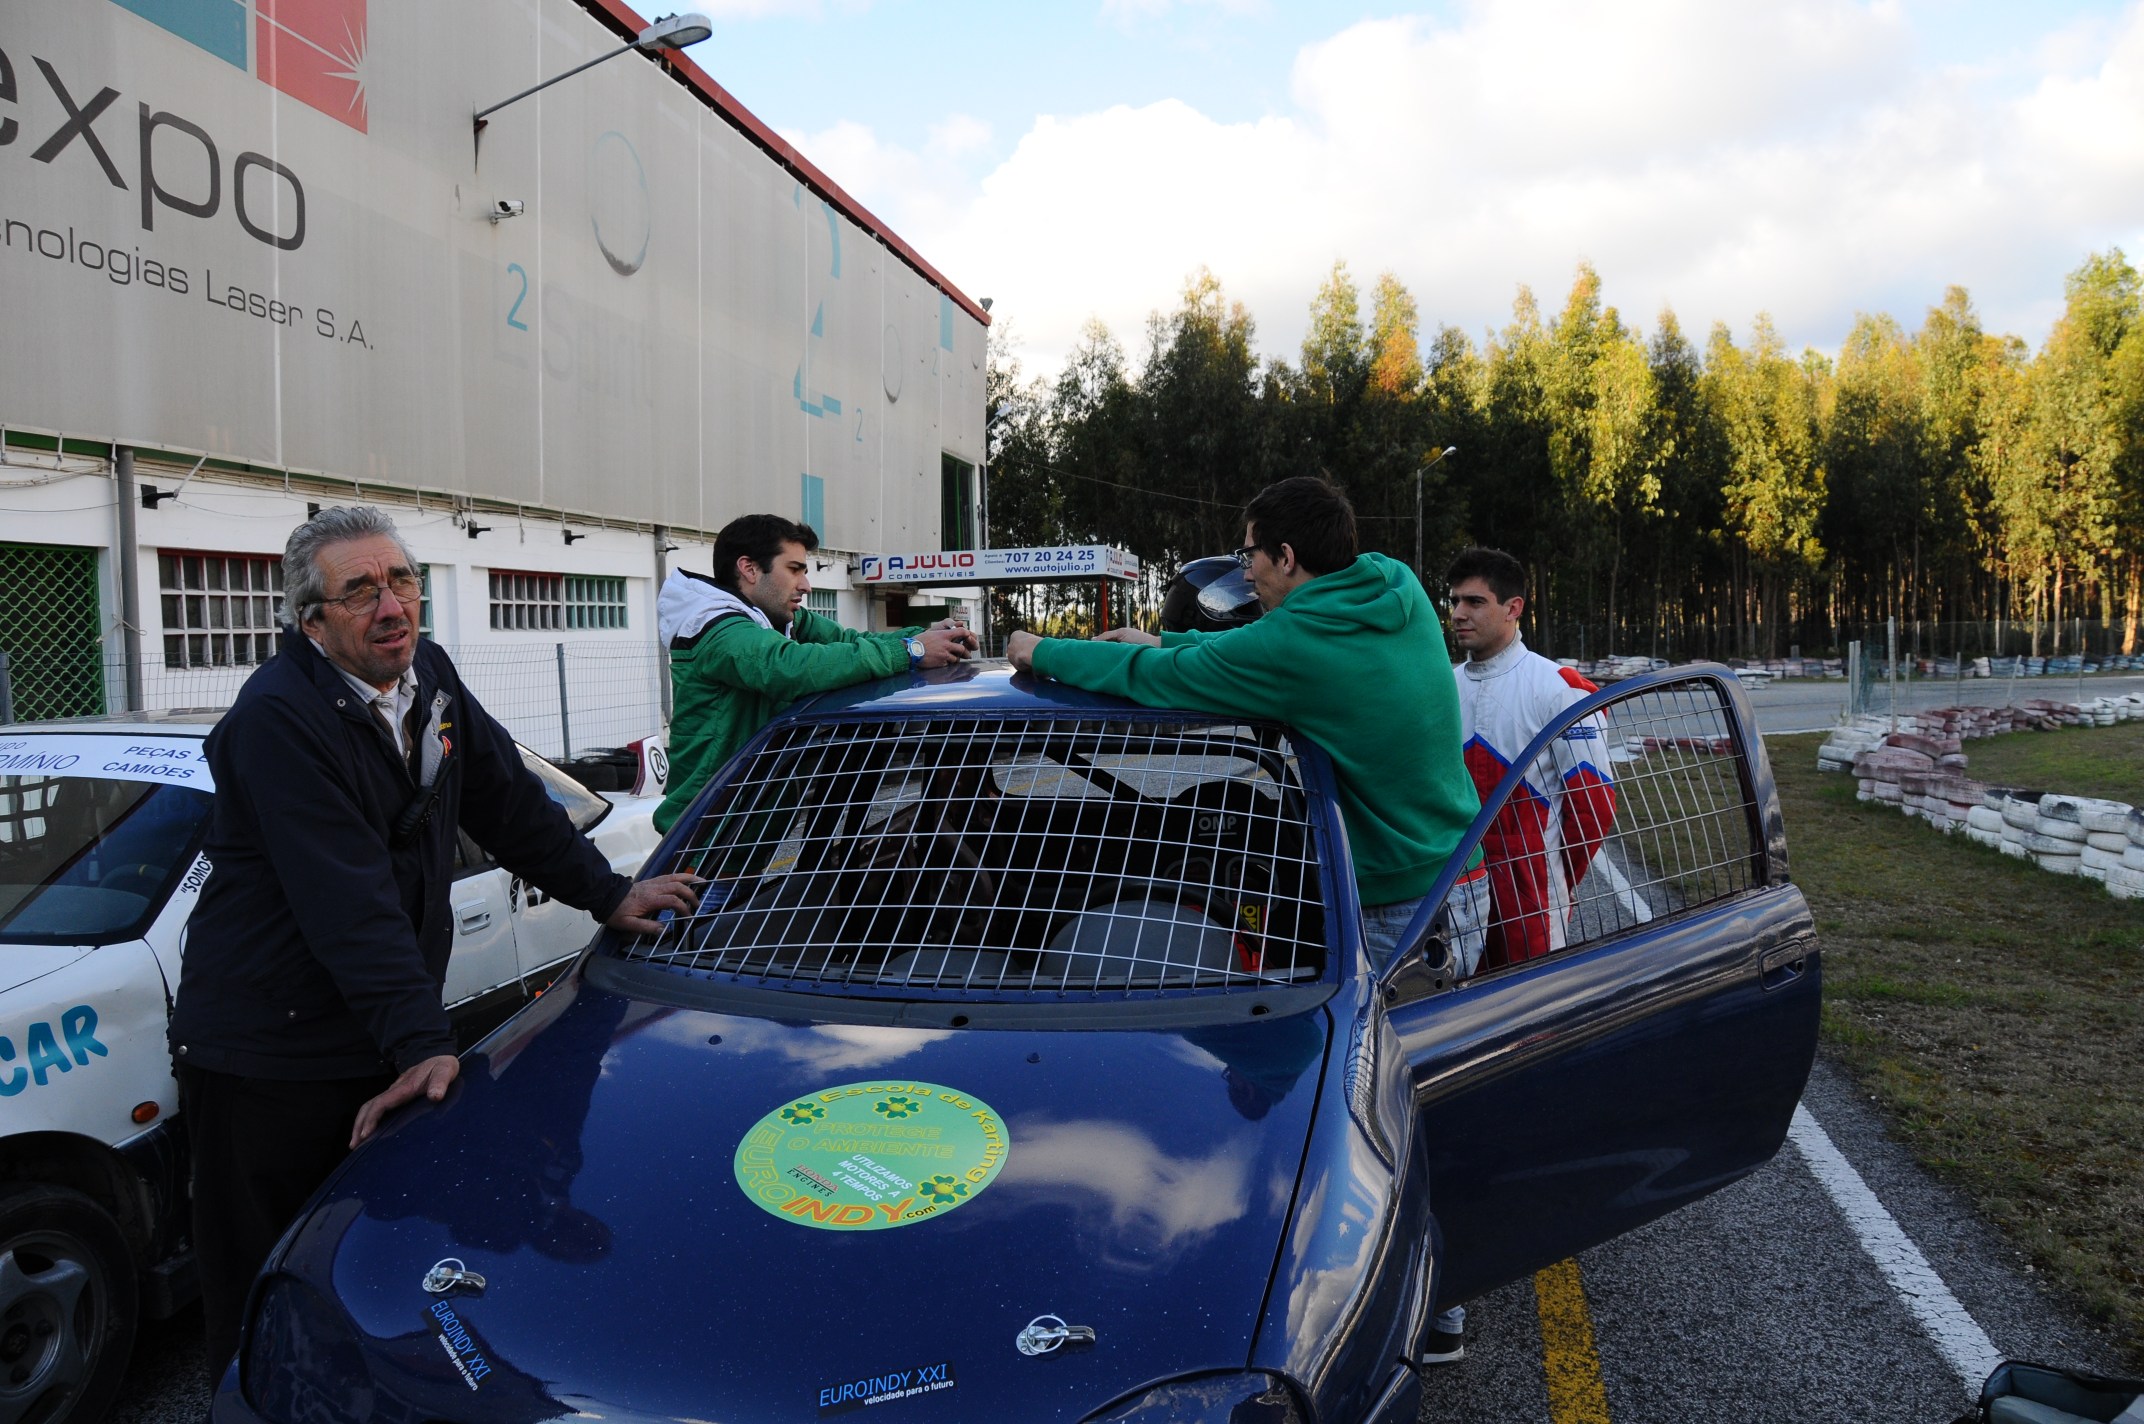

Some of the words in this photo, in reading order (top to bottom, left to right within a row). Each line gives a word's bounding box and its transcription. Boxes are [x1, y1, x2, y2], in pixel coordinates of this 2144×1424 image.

[0, 46, 306, 251] xpo
[0, 219, 189, 295] nologias
[206, 269, 303, 327] Laser
[316, 308, 374, 350] S.A.
[1005, 552, 1029, 564] 707
[1035, 551, 1051, 562] 20
[1056, 550, 1073, 561] 24
[1078, 550, 1095, 560] 25
[1005, 562, 1095, 574] www.autojulio.pt
[123, 746, 191, 759] PEÇAS
[102, 761, 195, 779] CAMIÕES
[1199, 815, 1236, 830] OMP
[0, 1005, 108, 1096] CAR
[813, 1122, 942, 1140] PROTEGE
[818, 1084, 932, 1103] Escola
[939, 1091, 971, 1110] de
[966, 1109, 1004, 1183] Karting
[814, 1138, 955, 1159] AMBIENTE
[787, 1169, 833, 1197] ENGINES
[797, 1164, 839, 1192] HONDA
[838, 1160, 889, 1190] MOTORES
[888, 1190, 901, 1198] A
[852, 1153, 912, 1190] UTILIZAMOS
[840, 1175, 882, 1201] TEMPOS
[431, 1300, 476, 1355] EUROINDY
[466, 1353, 492, 1380] XXI
[452, 1358, 465, 1371] para
[464, 1372, 478, 1391] futuro
[820, 1370, 911, 1407] EUROINDY
[917, 1364, 947, 1385] XXI
[864, 1390, 904, 1405] velocidade
[905, 1386, 922, 1397] para
[931, 1380, 954, 1391] futuro
